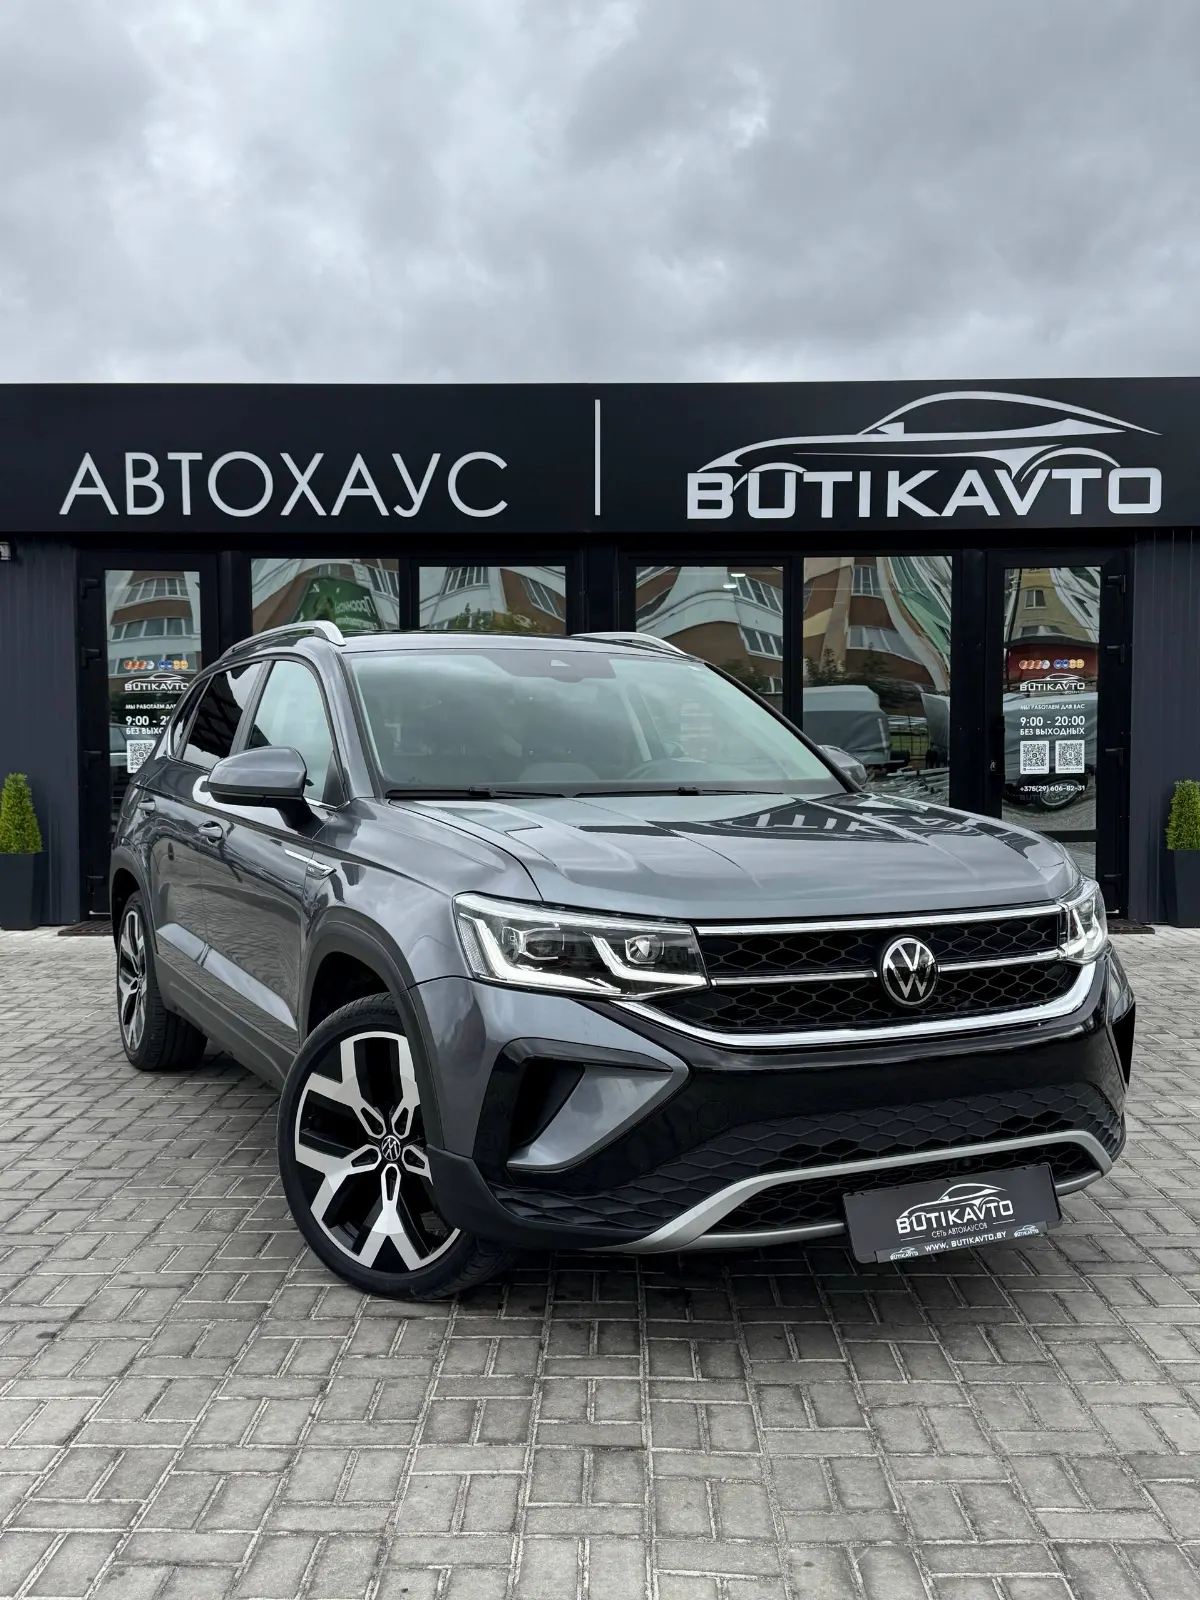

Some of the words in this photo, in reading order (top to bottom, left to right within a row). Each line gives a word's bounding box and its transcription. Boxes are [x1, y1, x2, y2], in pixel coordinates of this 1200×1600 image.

[59, 450, 508, 518] АВТОХАУС
[686, 467, 1162, 520] BUTIKAVTO
[124, 682, 189, 691] BUTIKAVTO
[1020, 682, 1085, 691] BUTIKAVTO
[125, 715, 150, 726] 9:00
[1020, 716, 1044, 726] 9:00
[1054, 715, 1086, 726] 20:00
[125, 727, 140, 735] БЕЗ
[1020, 728, 1034, 736] БЕЗ
[1035, 727, 1085, 736] ВЫХОДНЫХ
[895, 1199, 1014, 1234] BUTIKAVTO
[931, 1229, 947, 1238] СЕТЬ
[947, 1222, 988, 1236] АВТОХАУСОВ
[924, 1241, 949, 1253] WWW.
[950, 1231, 1007, 1248] BUTIKAVTO.BY
